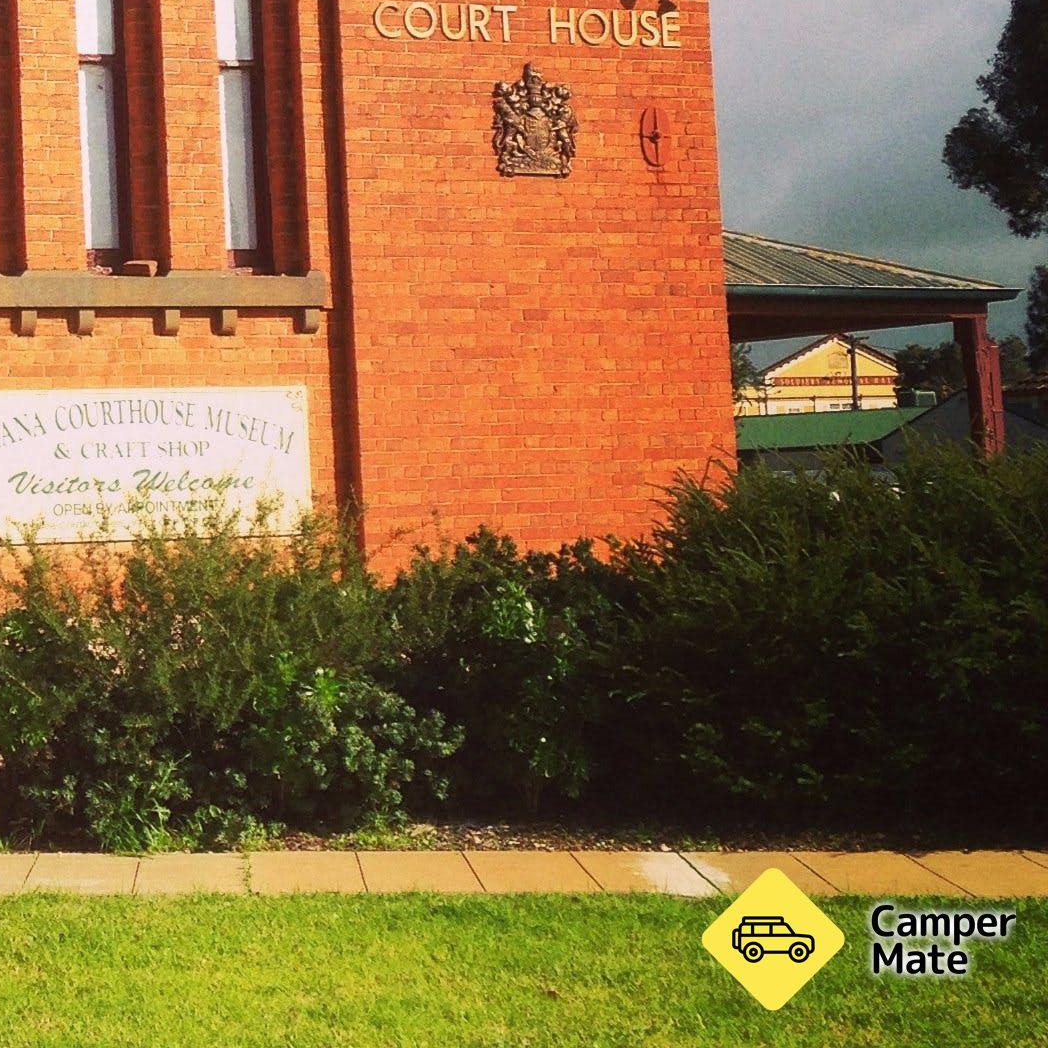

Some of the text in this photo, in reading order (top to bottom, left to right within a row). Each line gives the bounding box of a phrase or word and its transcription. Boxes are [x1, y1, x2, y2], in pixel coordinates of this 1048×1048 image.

[374, 1, 682, 49] COURT HOUSE
[822, 377, 870, 385] MEMOAL
[874, 376, 895, 384] HAL
[54, 399, 196, 432] COURTHOUSE
[204, 406, 295, 455] MUSEUM
[54, 440, 211, 460] & CRAFT SHOP
[7, 468, 255, 495] Visitors Welcome
[53, 503, 92, 516] OPEN
[96, 502, 112, 514] BY
